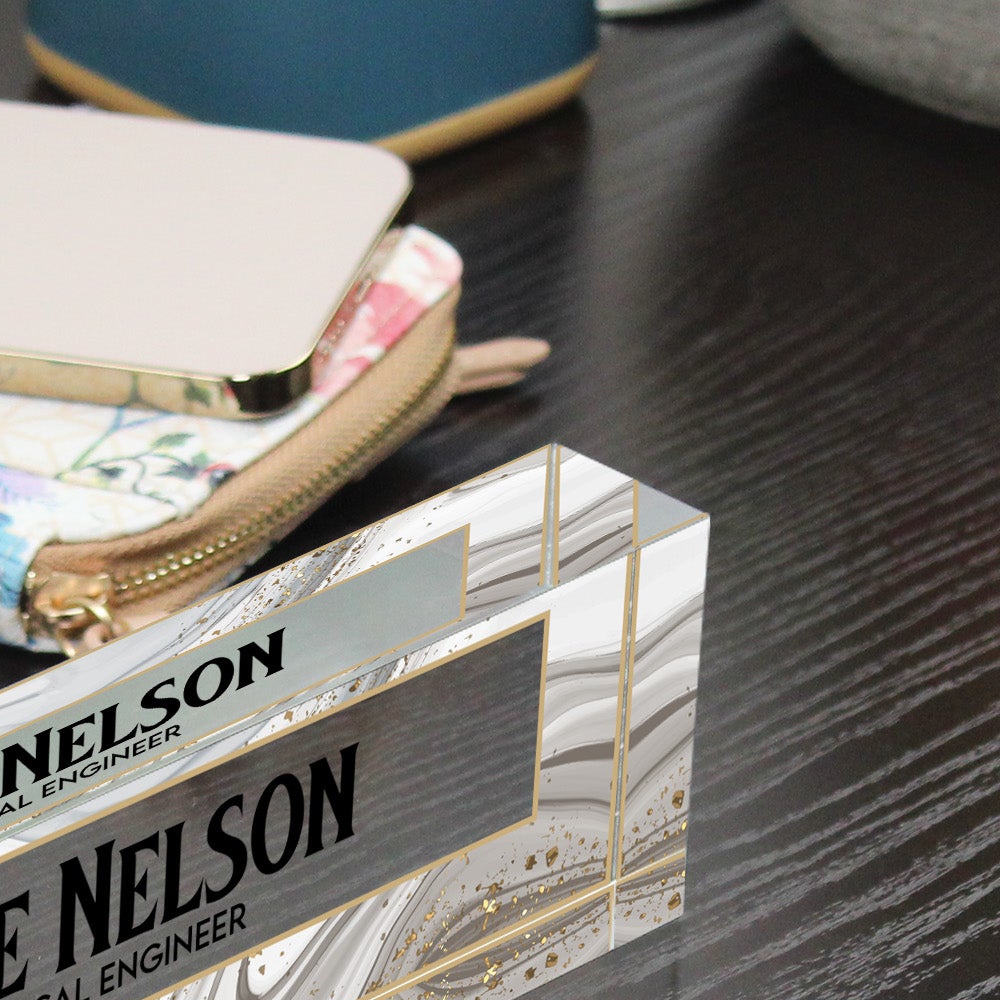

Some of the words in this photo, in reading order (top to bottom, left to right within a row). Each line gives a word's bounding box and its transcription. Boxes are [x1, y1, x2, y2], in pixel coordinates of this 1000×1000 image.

[42, 724, 182, 799] ENGINEER
[54, 742, 360, 974] NELSON
[100, 903, 247, 996] ENGINEER
